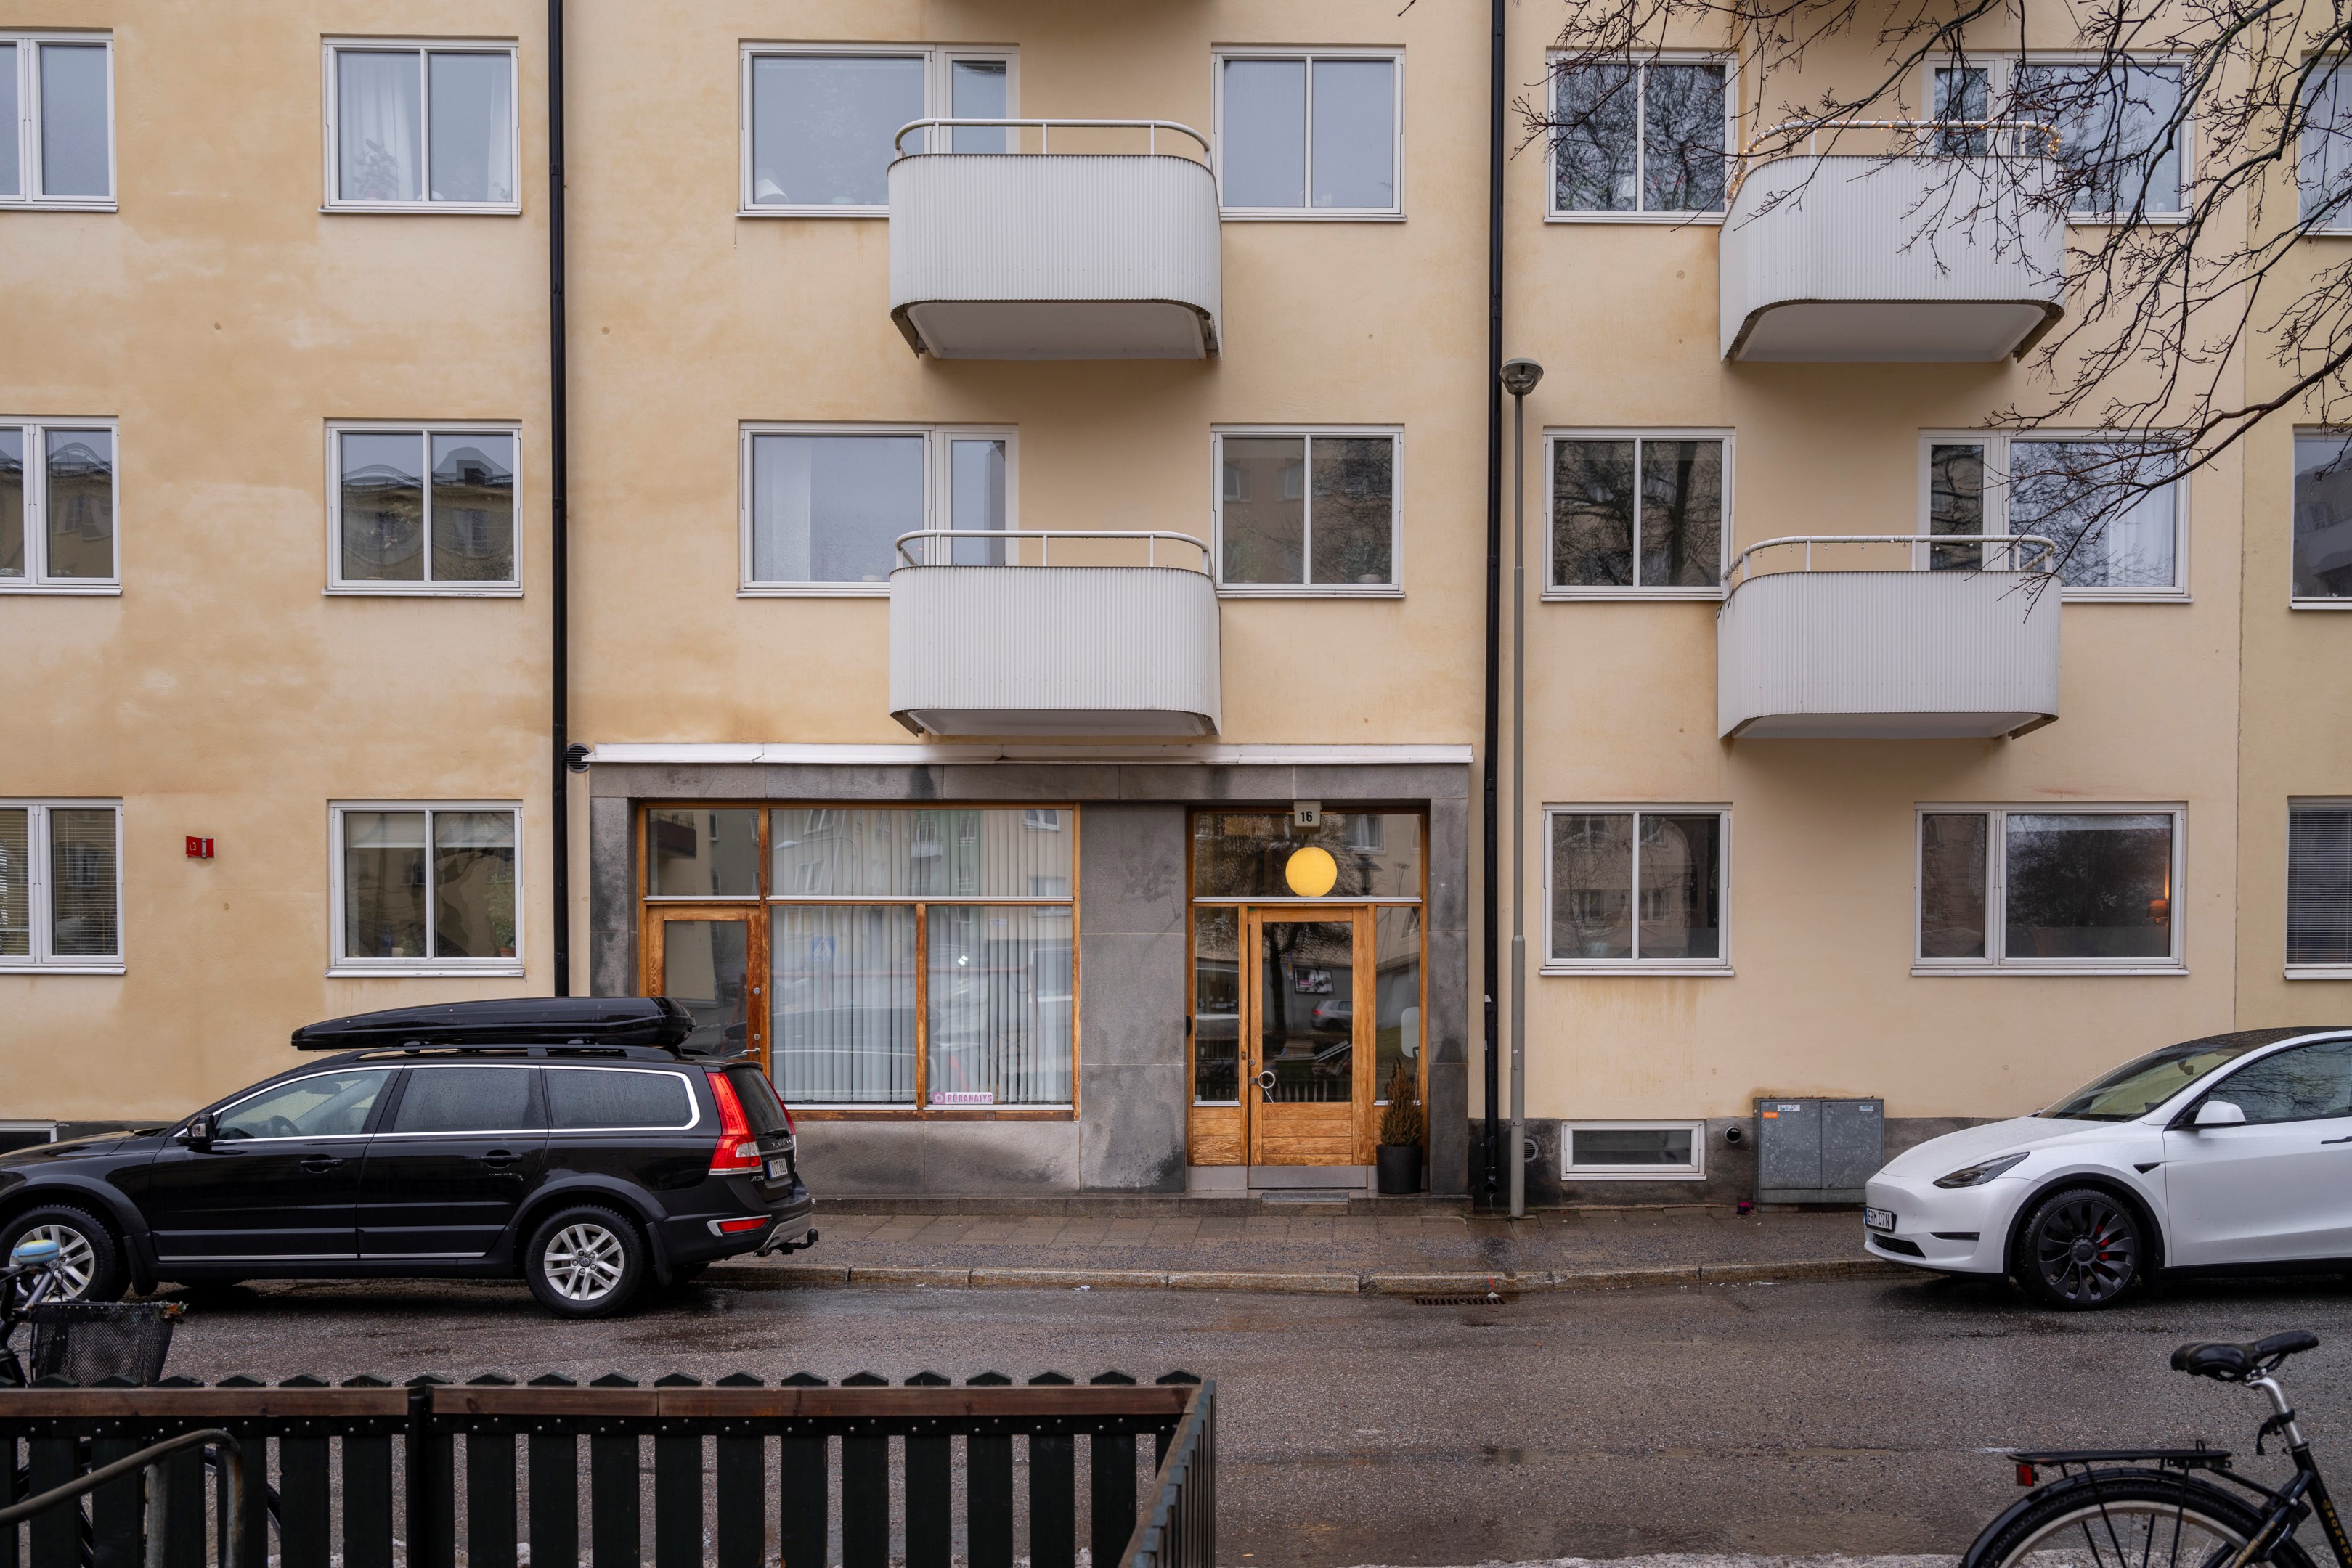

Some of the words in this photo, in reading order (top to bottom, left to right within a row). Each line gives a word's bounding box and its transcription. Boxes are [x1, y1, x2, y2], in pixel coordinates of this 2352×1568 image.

[1300, 811, 1313, 822] 16
[947, 1093, 993, 1103] RÖRANALYS
[1868, 1209, 1877, 1225] ERM
